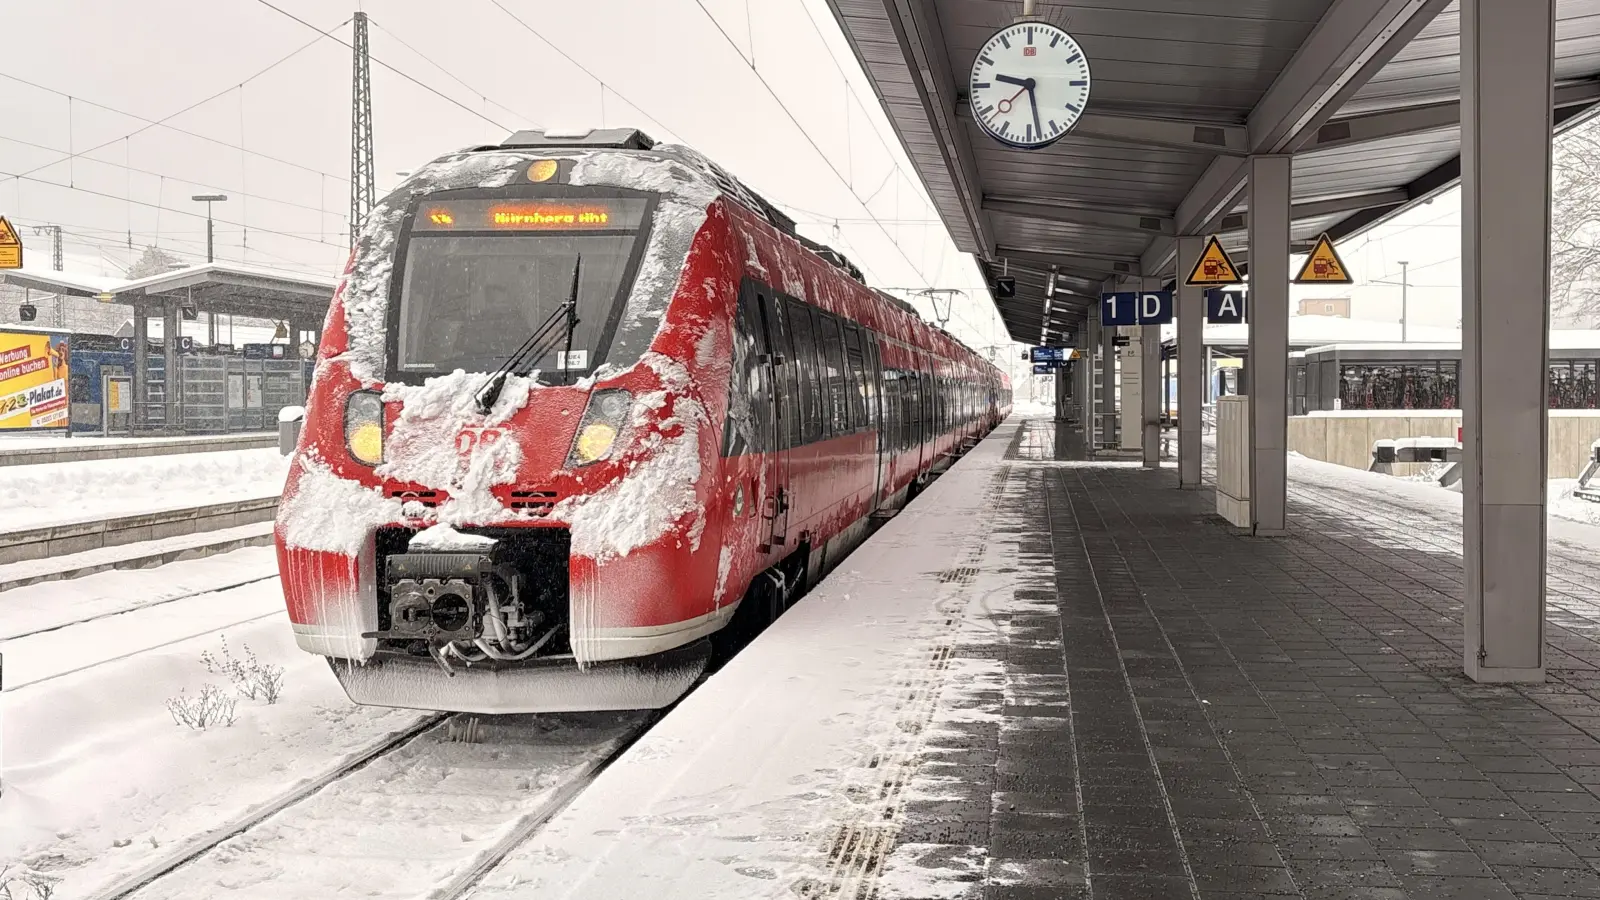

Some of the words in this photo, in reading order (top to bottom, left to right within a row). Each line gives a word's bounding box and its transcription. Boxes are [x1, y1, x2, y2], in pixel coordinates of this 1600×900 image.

[1025, 47, 1035, 56] DB
[1106, 295, 1117, 319] 1
[1142, 294, 1161, 318] D
[1217, 293, 1238, 317] A
[120, 338, 130, 350] C
[181, 337, 191, 349] C
[21, 359, 46, 374] buchen
